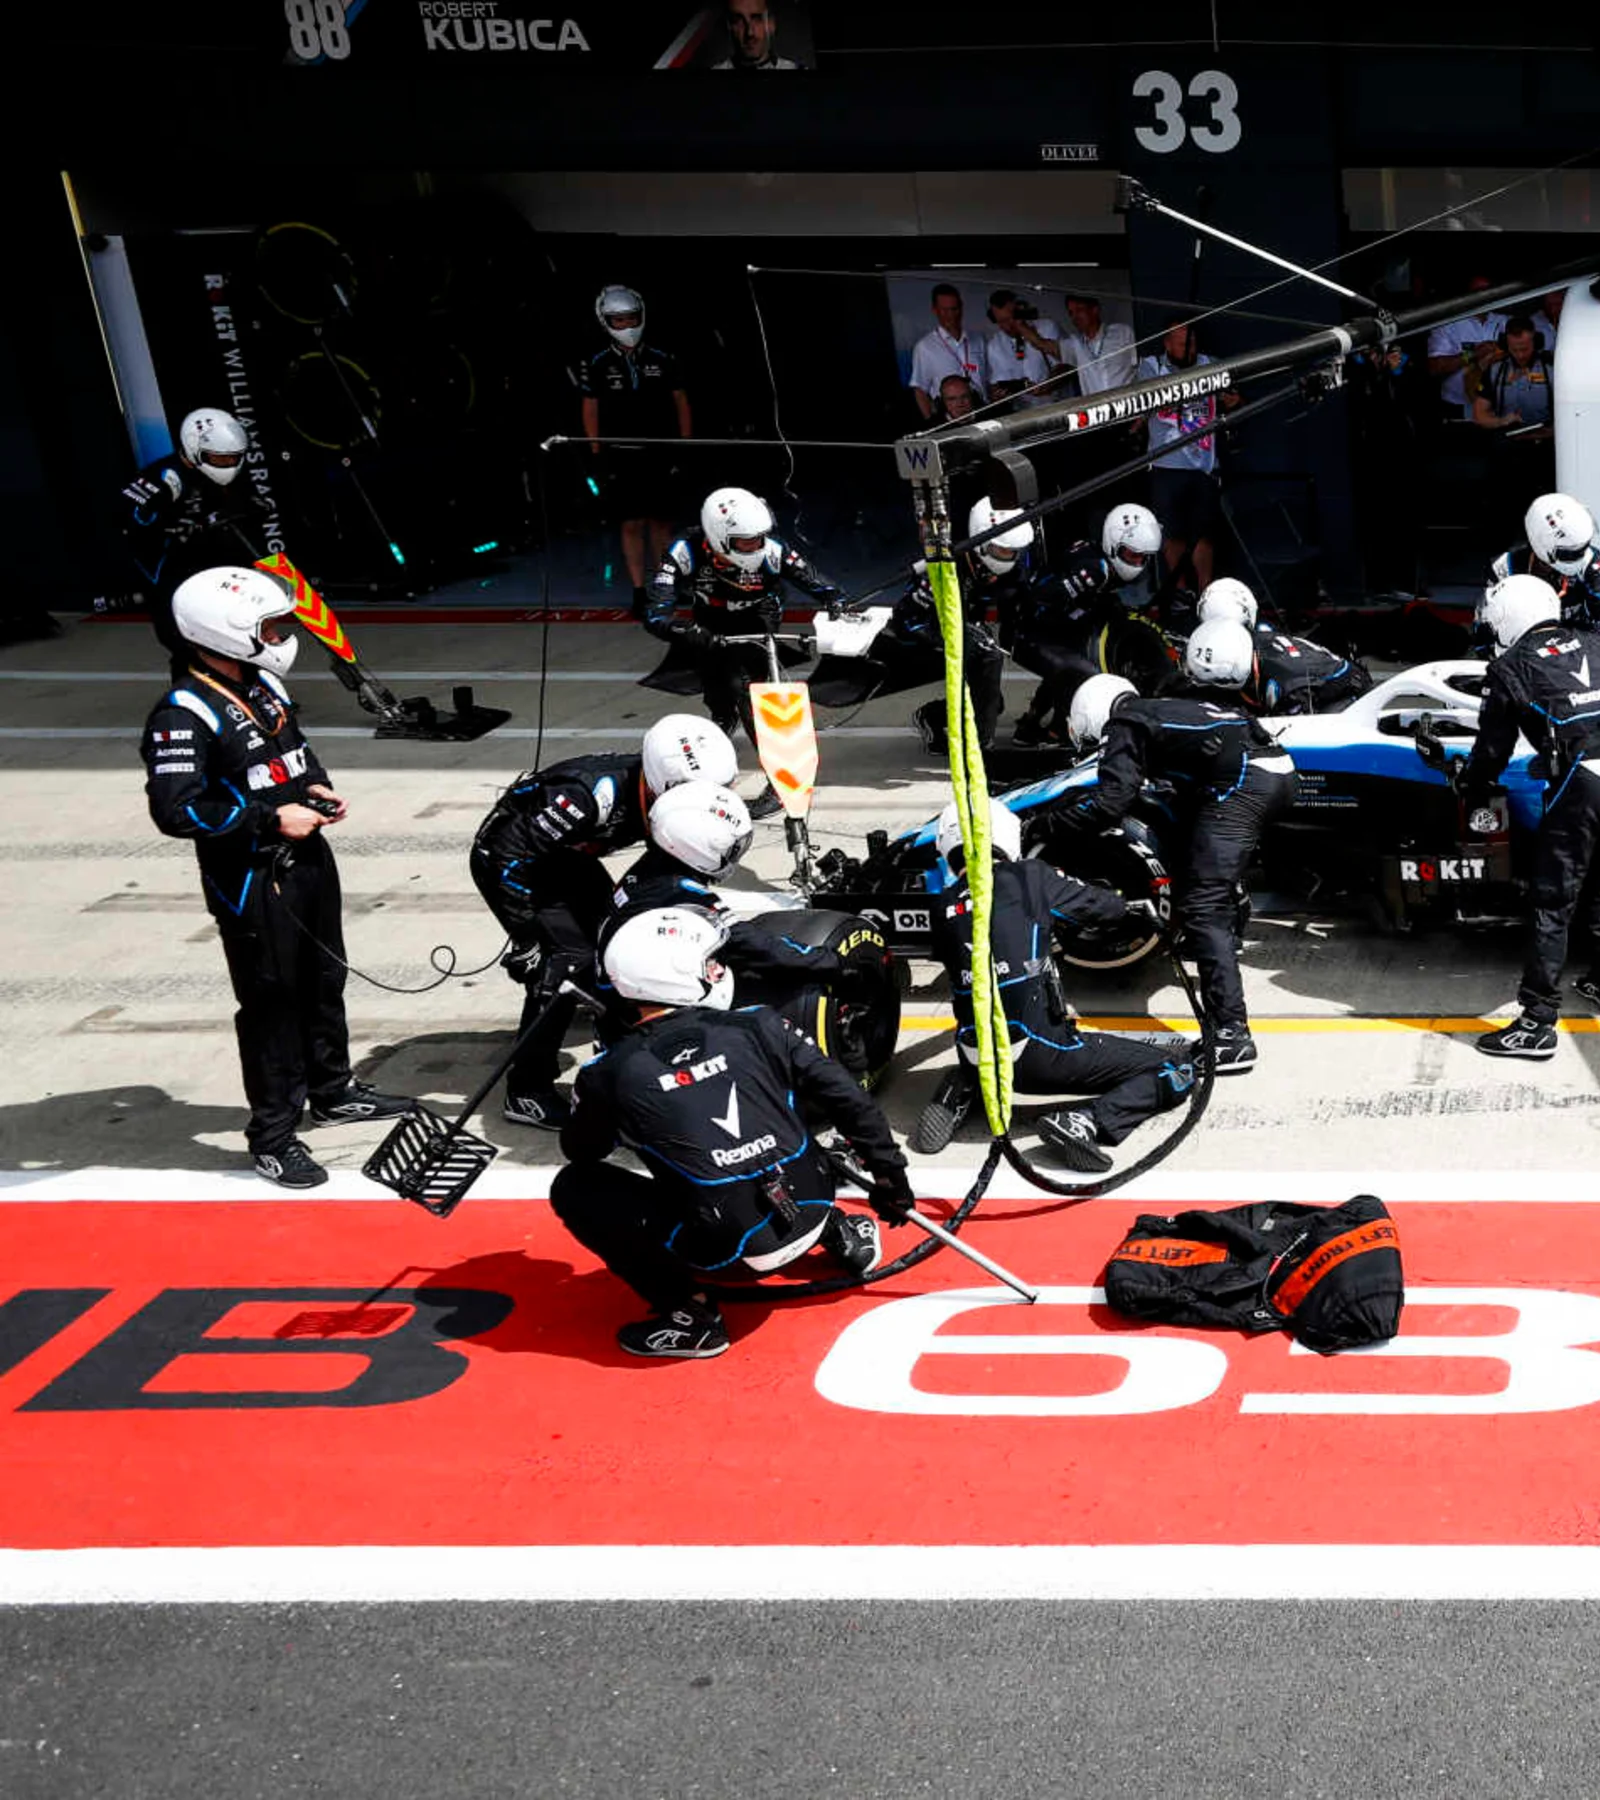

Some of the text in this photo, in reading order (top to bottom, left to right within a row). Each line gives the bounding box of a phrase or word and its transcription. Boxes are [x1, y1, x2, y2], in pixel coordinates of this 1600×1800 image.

[419, 1, 499, 18] ROBERT
[284, 0, 351, 60] 88
[423, 18, 592, 51] KUBICA
[1132, 70, 1242, 153] 33
[1041, 147, 1098, 159] OLIVER
[1112, 384, 1181, 420] WILLIAMS
[1181, 371, 1231, 400] RACING
[905, 447, 928, 470] W
[1400, 858, 1486, 881] ROKiT
[837, 929, 885, 956] ZERO
[711, 1134, 777, 1167] Rexona
